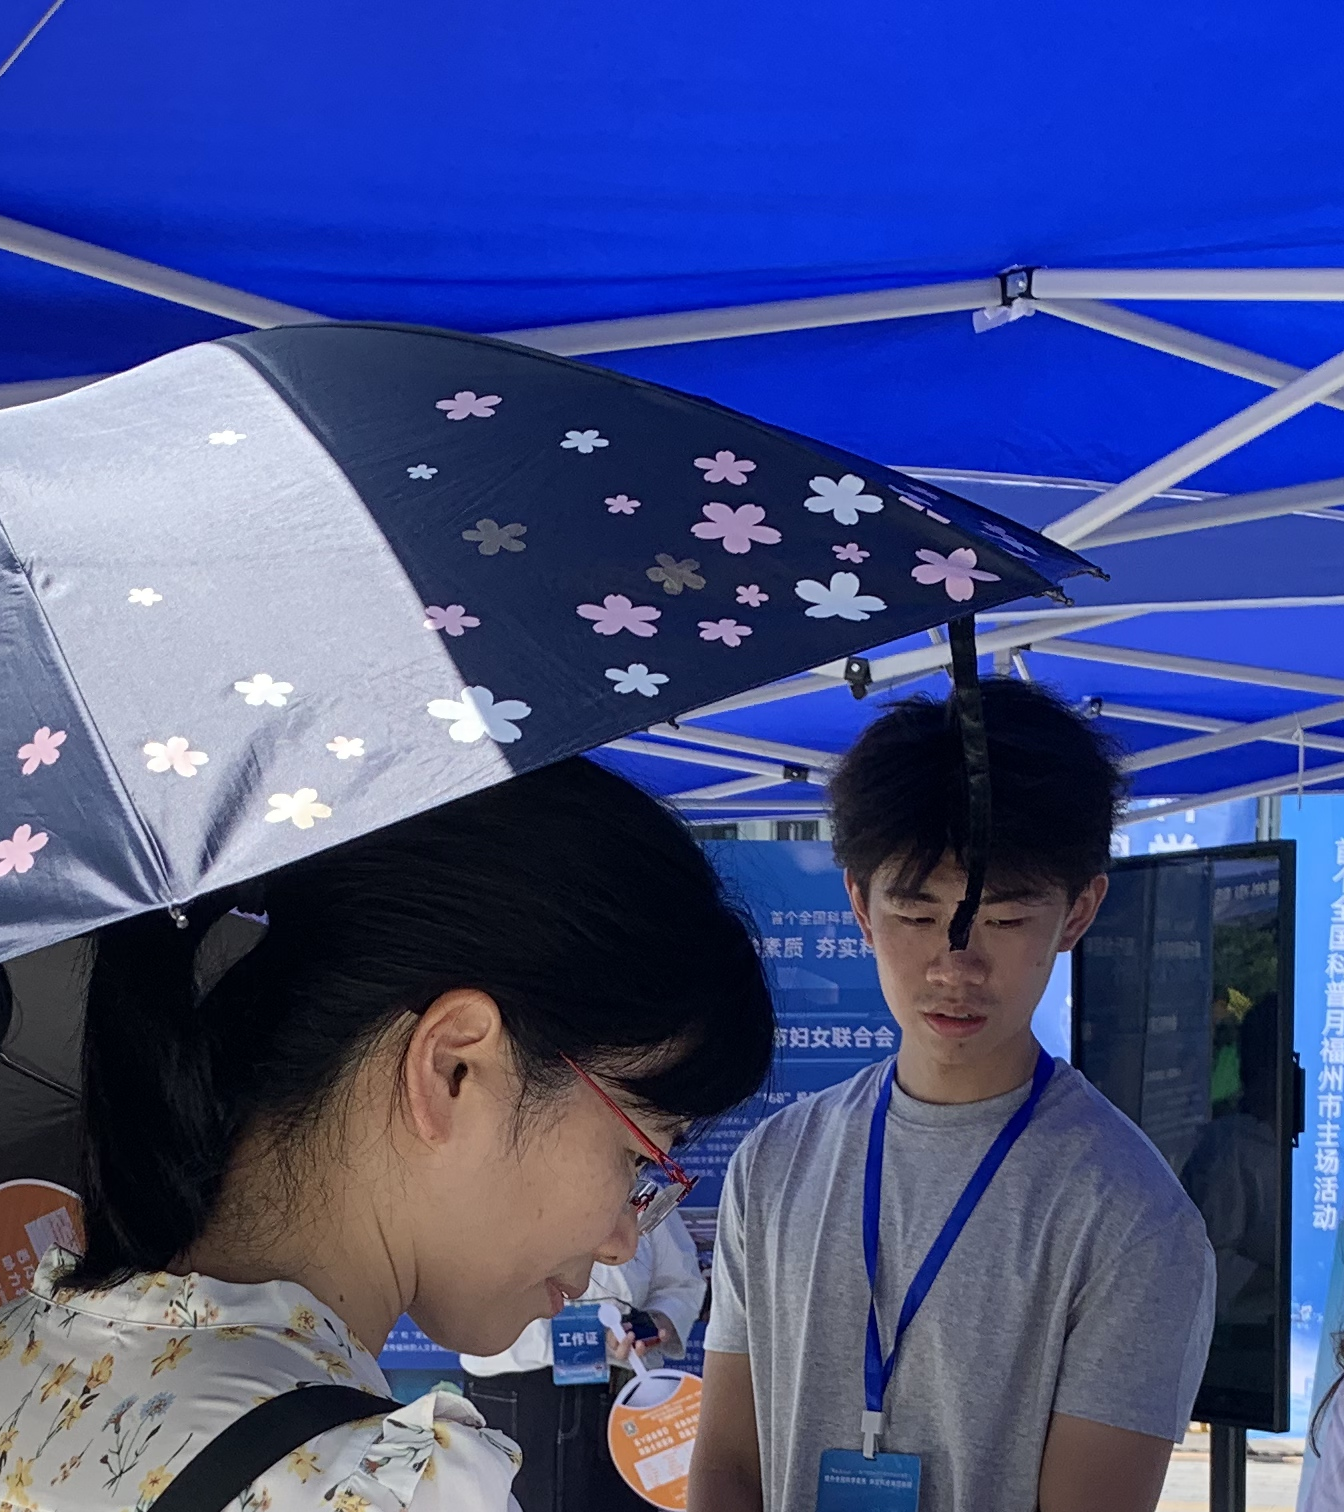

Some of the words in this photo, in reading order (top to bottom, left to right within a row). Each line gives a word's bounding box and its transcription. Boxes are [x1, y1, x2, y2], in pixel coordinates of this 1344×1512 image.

[754, 937, 803, 960] 素质
[558, 1331, 598, 1348] 工作证
